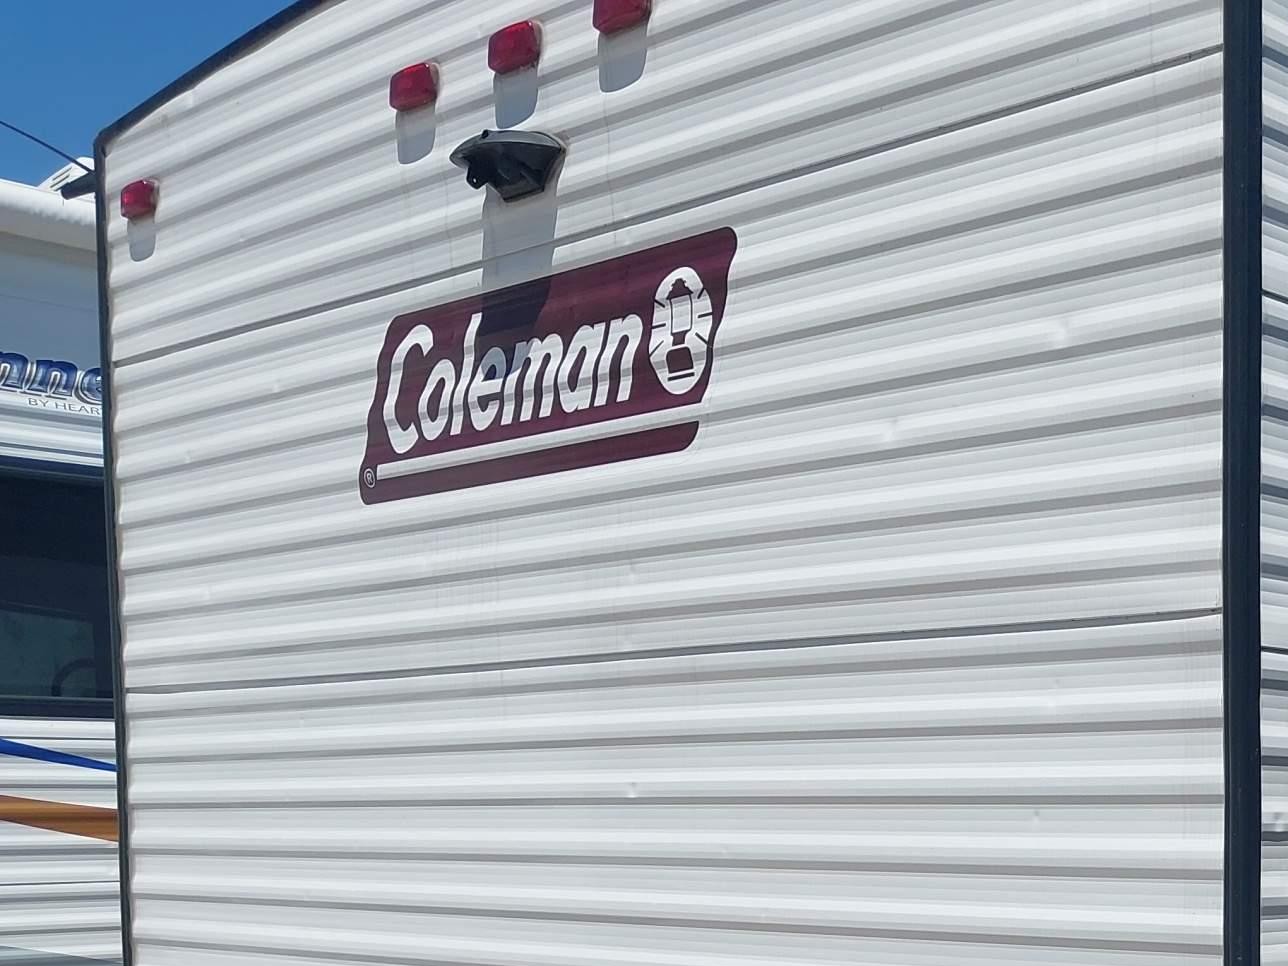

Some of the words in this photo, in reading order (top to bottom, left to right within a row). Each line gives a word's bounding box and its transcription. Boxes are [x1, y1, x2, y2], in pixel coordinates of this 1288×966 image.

[28, 398, 49, 407] BY
[55, 402, 102, 415] HEAR
[383, 312, 643, 454] Coleman
